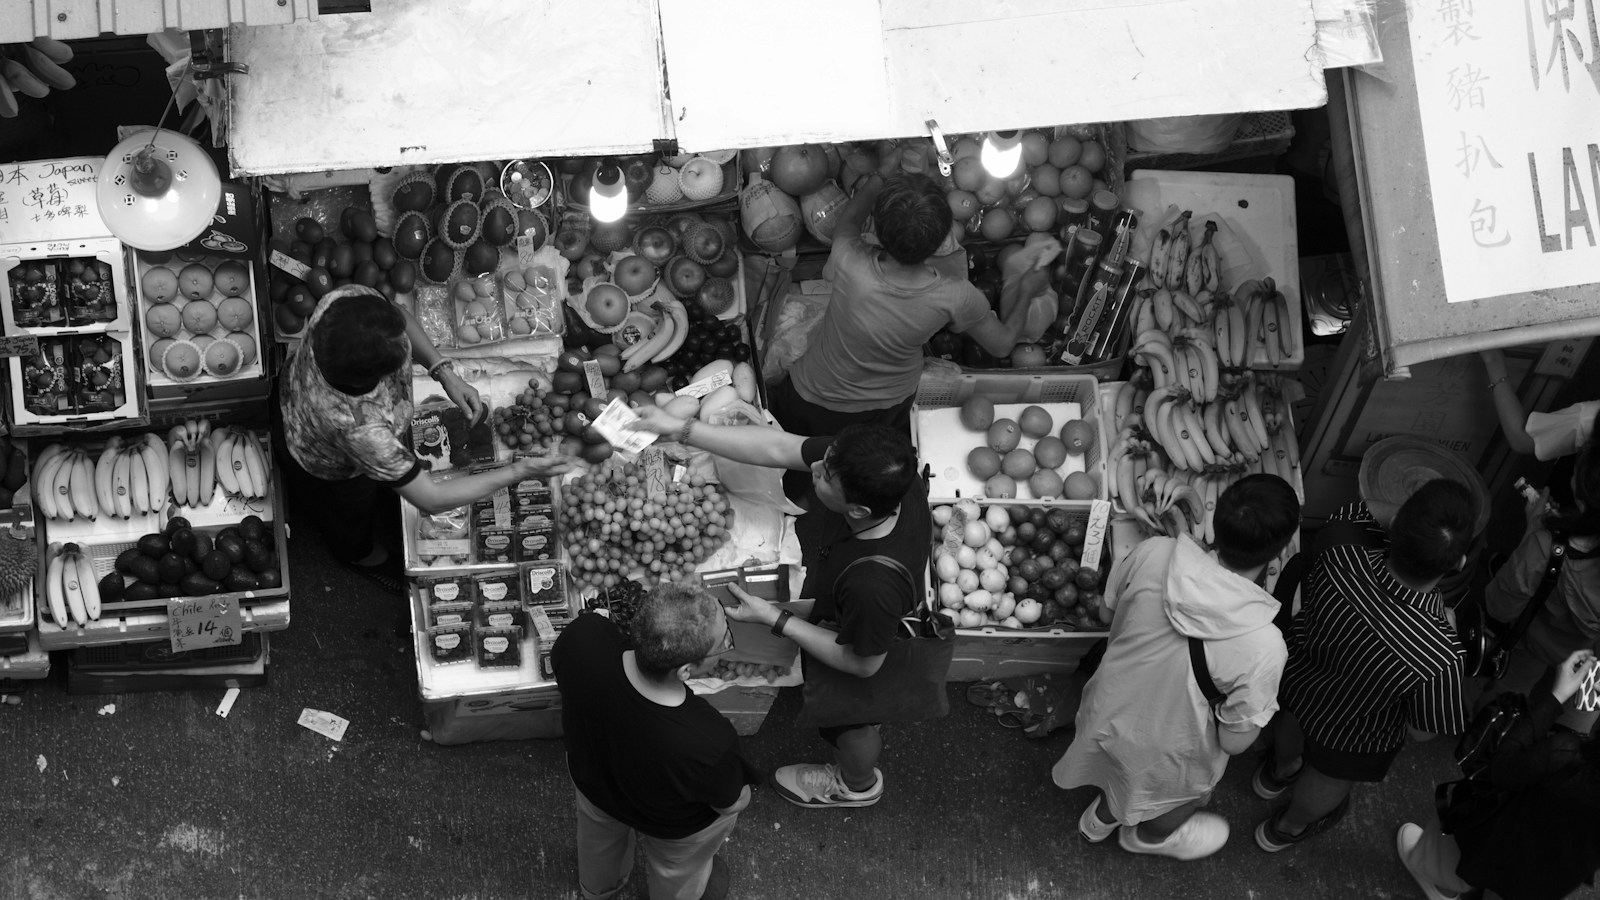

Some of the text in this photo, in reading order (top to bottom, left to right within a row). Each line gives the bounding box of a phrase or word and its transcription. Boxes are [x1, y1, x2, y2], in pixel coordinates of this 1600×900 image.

[39, 162, 93, 180] Japan
[1081, 296, 1102, 333] ROCKIT
[172, 602, 204, 617] Chile
